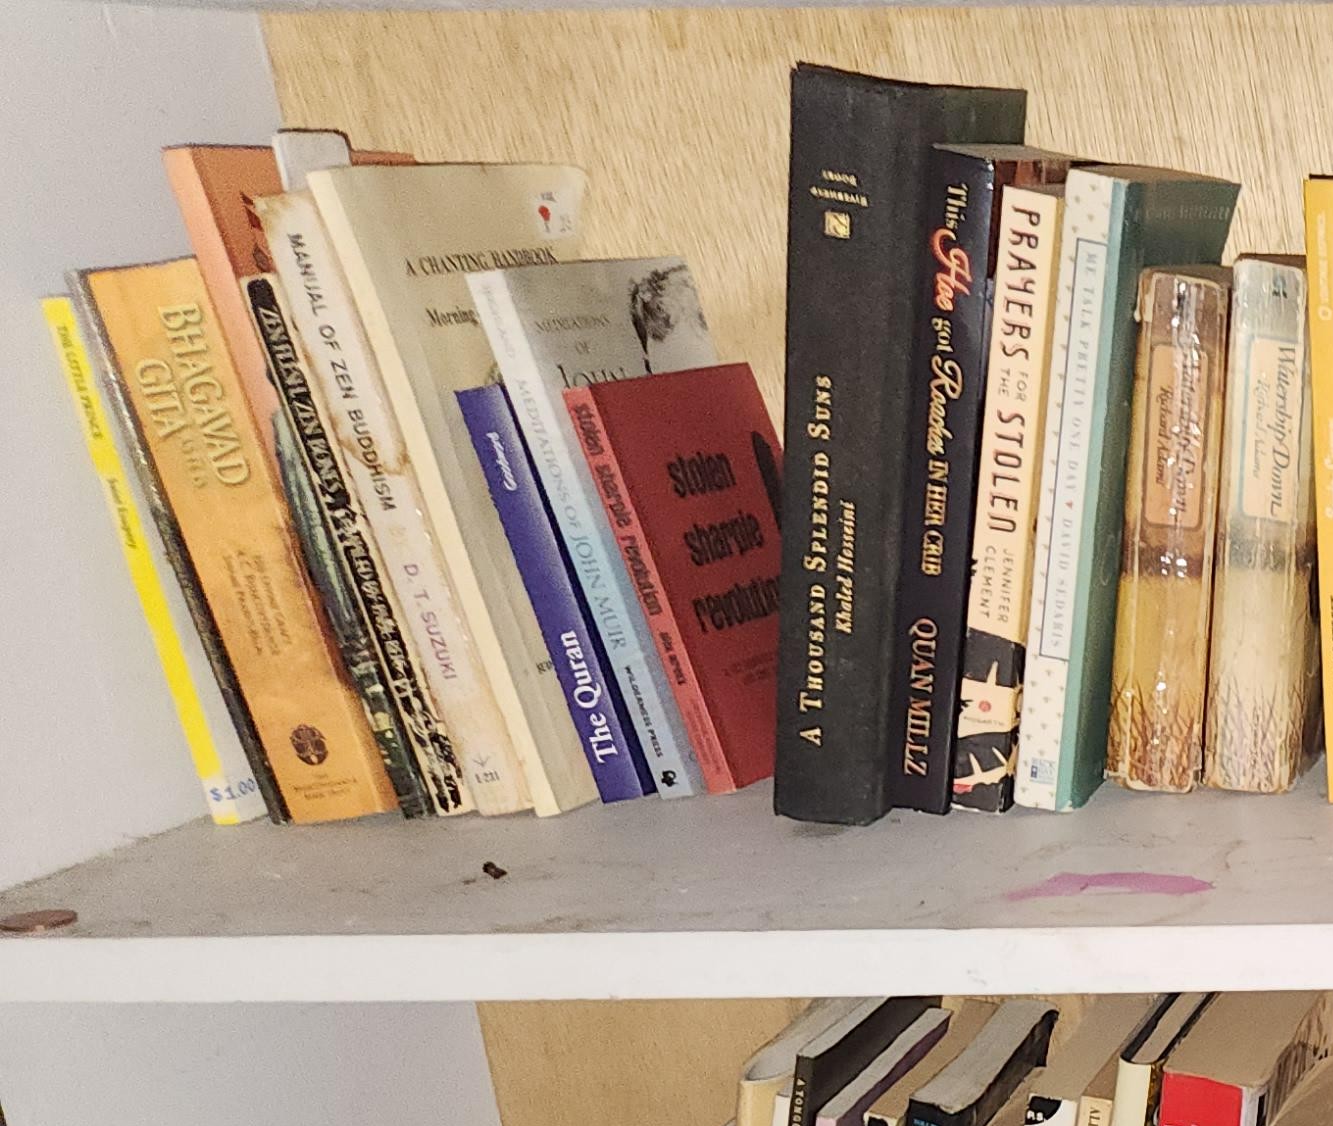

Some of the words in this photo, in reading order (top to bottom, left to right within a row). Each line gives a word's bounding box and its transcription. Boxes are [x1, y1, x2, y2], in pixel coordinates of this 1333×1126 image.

[405, 259, 417, 277] A
[418, 251, 489, 275] CHANTING
[491, 246, 560, 270] HANDBOOK
[1002, 204, 1042, 362] PRAYERS
[135, 357, 187, 440] GITA
[160, 302, 253, 486] BHAGAVAD
[287, 232, 321, 316] MANUAL
[318, 324, 341, 352] OF
[331, 360, 354, 402] ZEN
[349, 407, 397, 511] BUDDHISM
[806, 375, 834, 441] SUNS
[1000, 368, 1010, 396] THE
[1016, 369, 1029, 402] FOR
[805, 451, 831, 573] SPLENDID
[979, 545, 996, 619] CLEMENT
[996, 548, 1018, 623] JENNIFER
[404, 563, 419, 586] D.
[413, 590, 430, 612] T.
[424, 613, 457, 679] SUZUKI
[799, 586, 827, 714] THOUSAND
[908, 616, 938, 693] QUAN
[560, 630, 601, 708] Quran
[588, 713, 617, 764] The
[624, 665, 651, 726] WILDERNESS
[646, 727, 664, 758] PRESS
[800, 725, 823, 747] A
[903, 695, 933, 777] MILLZ
[210, 779, 257, 802] $1.00
